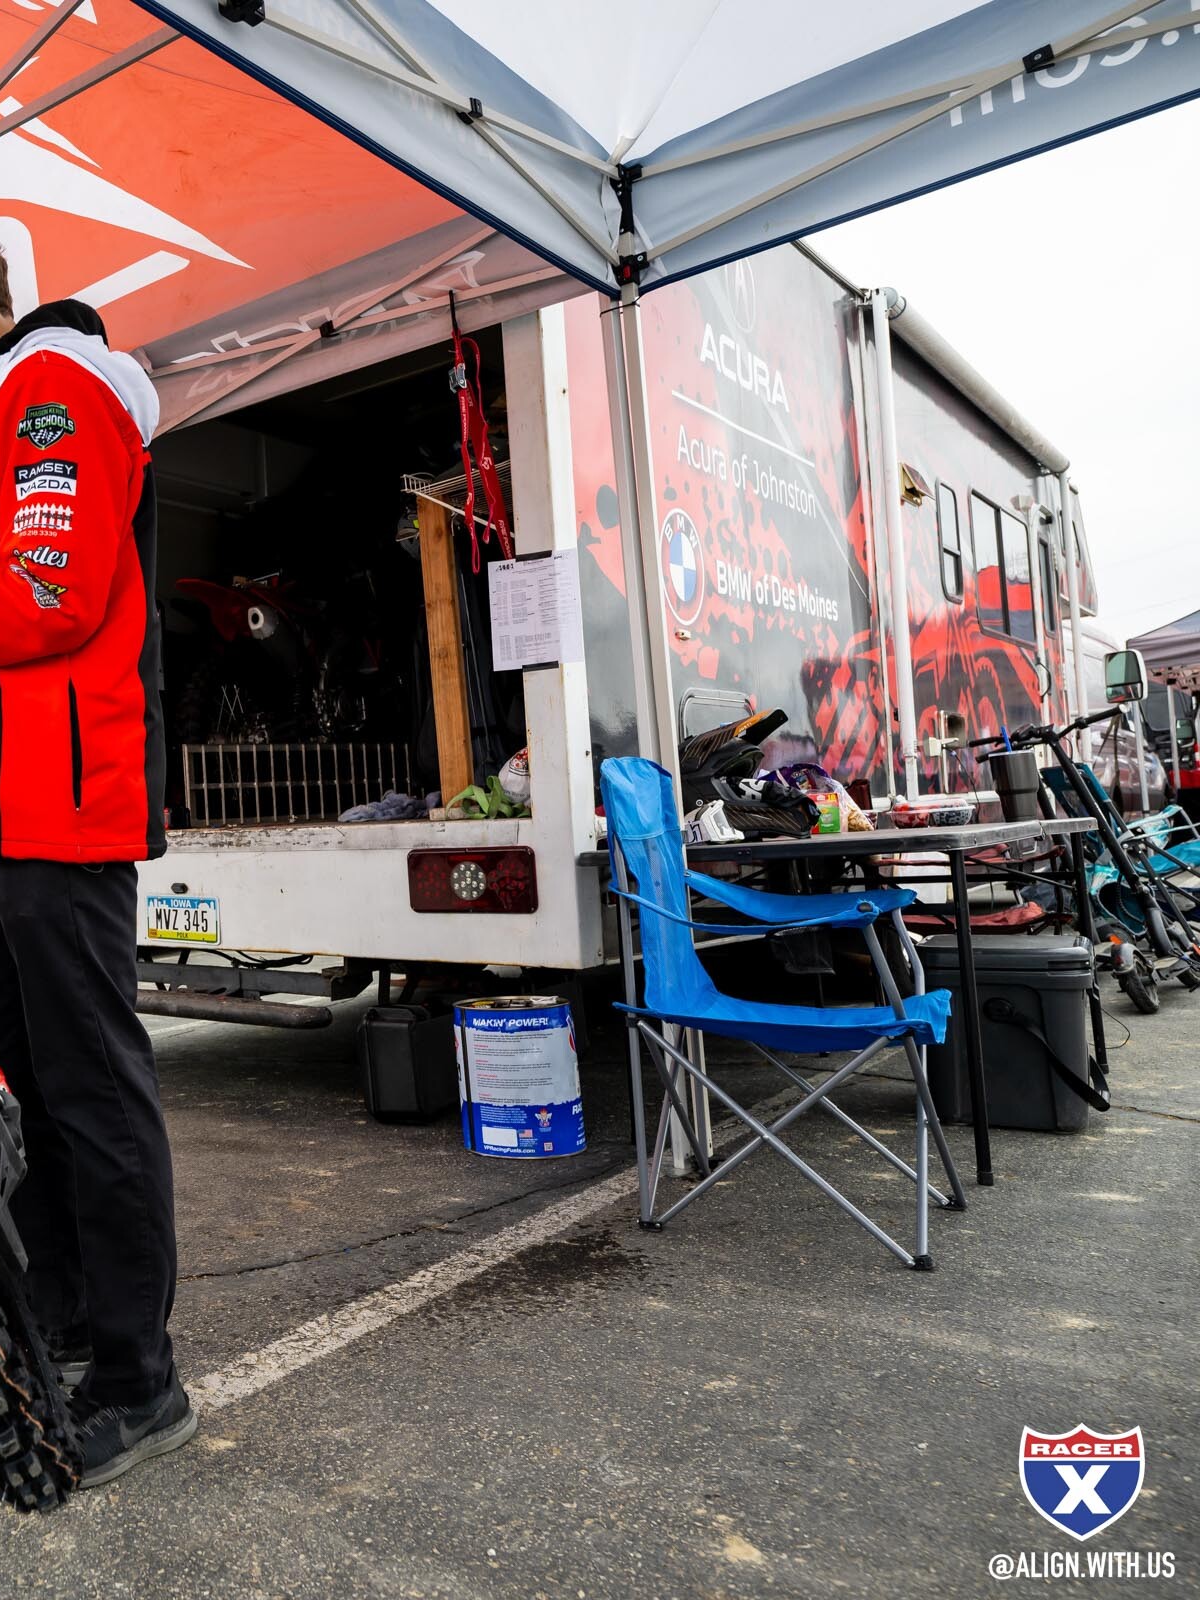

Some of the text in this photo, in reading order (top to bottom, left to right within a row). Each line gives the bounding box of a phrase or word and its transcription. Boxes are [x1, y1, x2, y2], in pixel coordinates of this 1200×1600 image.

[700, 322, 790, 413] ACURA
[19, 413, 75, 434] MX SCHOOLS
[18, 462, 74, 480] RAMSEY
[677, 424, 818, 520] Acura of Johnston
[19, 479, 73, 497] MAZDA
[716, 560, 840, 622] BMW of Des Moines
[170, 898, 192, 909] IOWA
[155, 908, 208, 933] MVZ 345
[472, 1016, 549, 1027] MAKIN' POWER!
[483, 1144, 536, 1154] VPRacingFuels.com
